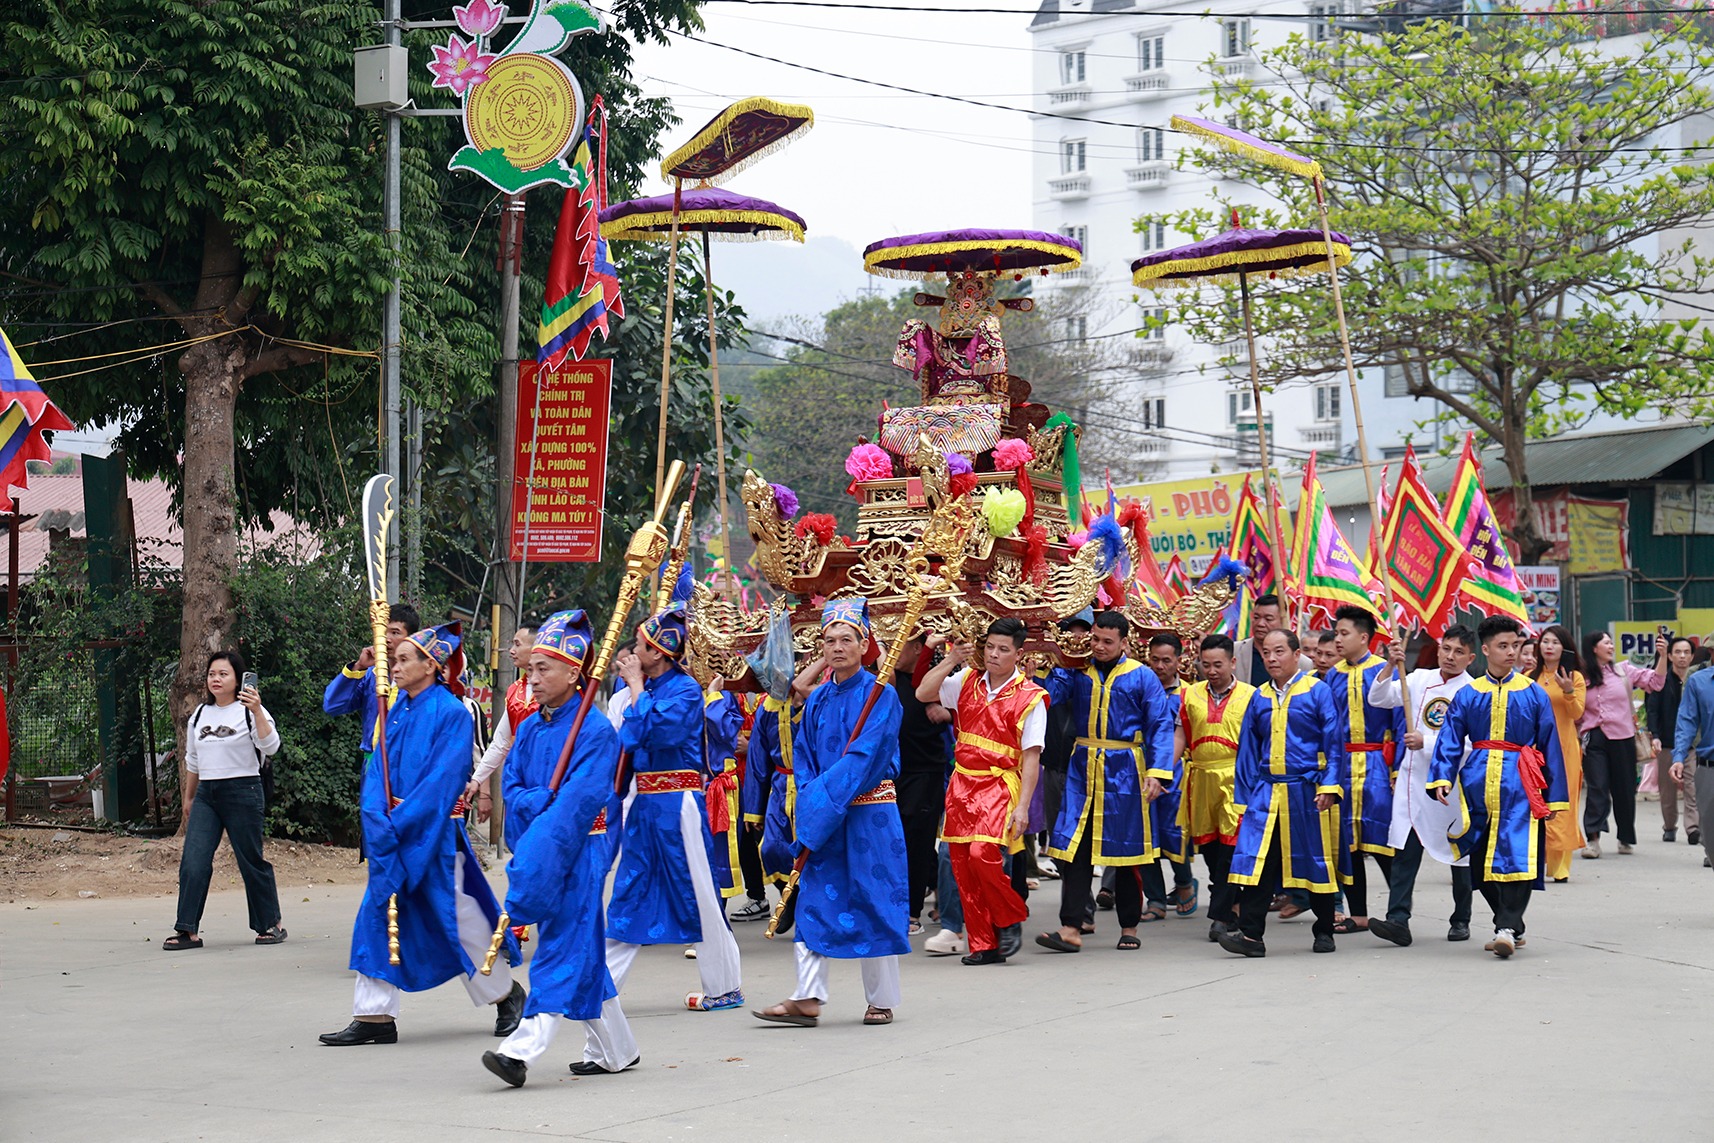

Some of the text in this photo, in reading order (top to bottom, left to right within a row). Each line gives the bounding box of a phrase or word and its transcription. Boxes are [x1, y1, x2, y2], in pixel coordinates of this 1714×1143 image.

[562, 369, 594, 384] THỐNG
[540, 389, 586, 403] CHÍNH TRỊ
[545, 406, 570, 419] TOÀN
[572, 405, 592, 419] DÂN
[565, 422, 586, 436] TÂM
[541, 441, 567, 455] DỰNG
[570, 442, 597, 454] 100%
[547, 457, 586, 470] PHƯỜNG
[551, 477, 567, 490] ĐỊA
[569, 475, 589, 488] BÀN
[528, 491, 548, 505] ỈNH
[1171, 480, 1231, 518] PHỞ
[551, 511, 567, 523] MA
[569, 509, 586, 523] TÚY
[588, 511, 593, 523] !
[1151, 531, 1175, 553] UÔI
[1177, 528, 1197, 551] BÒ
[1535, 573, 1558, 588] MINH
[466, 687, 493, 703] PH
